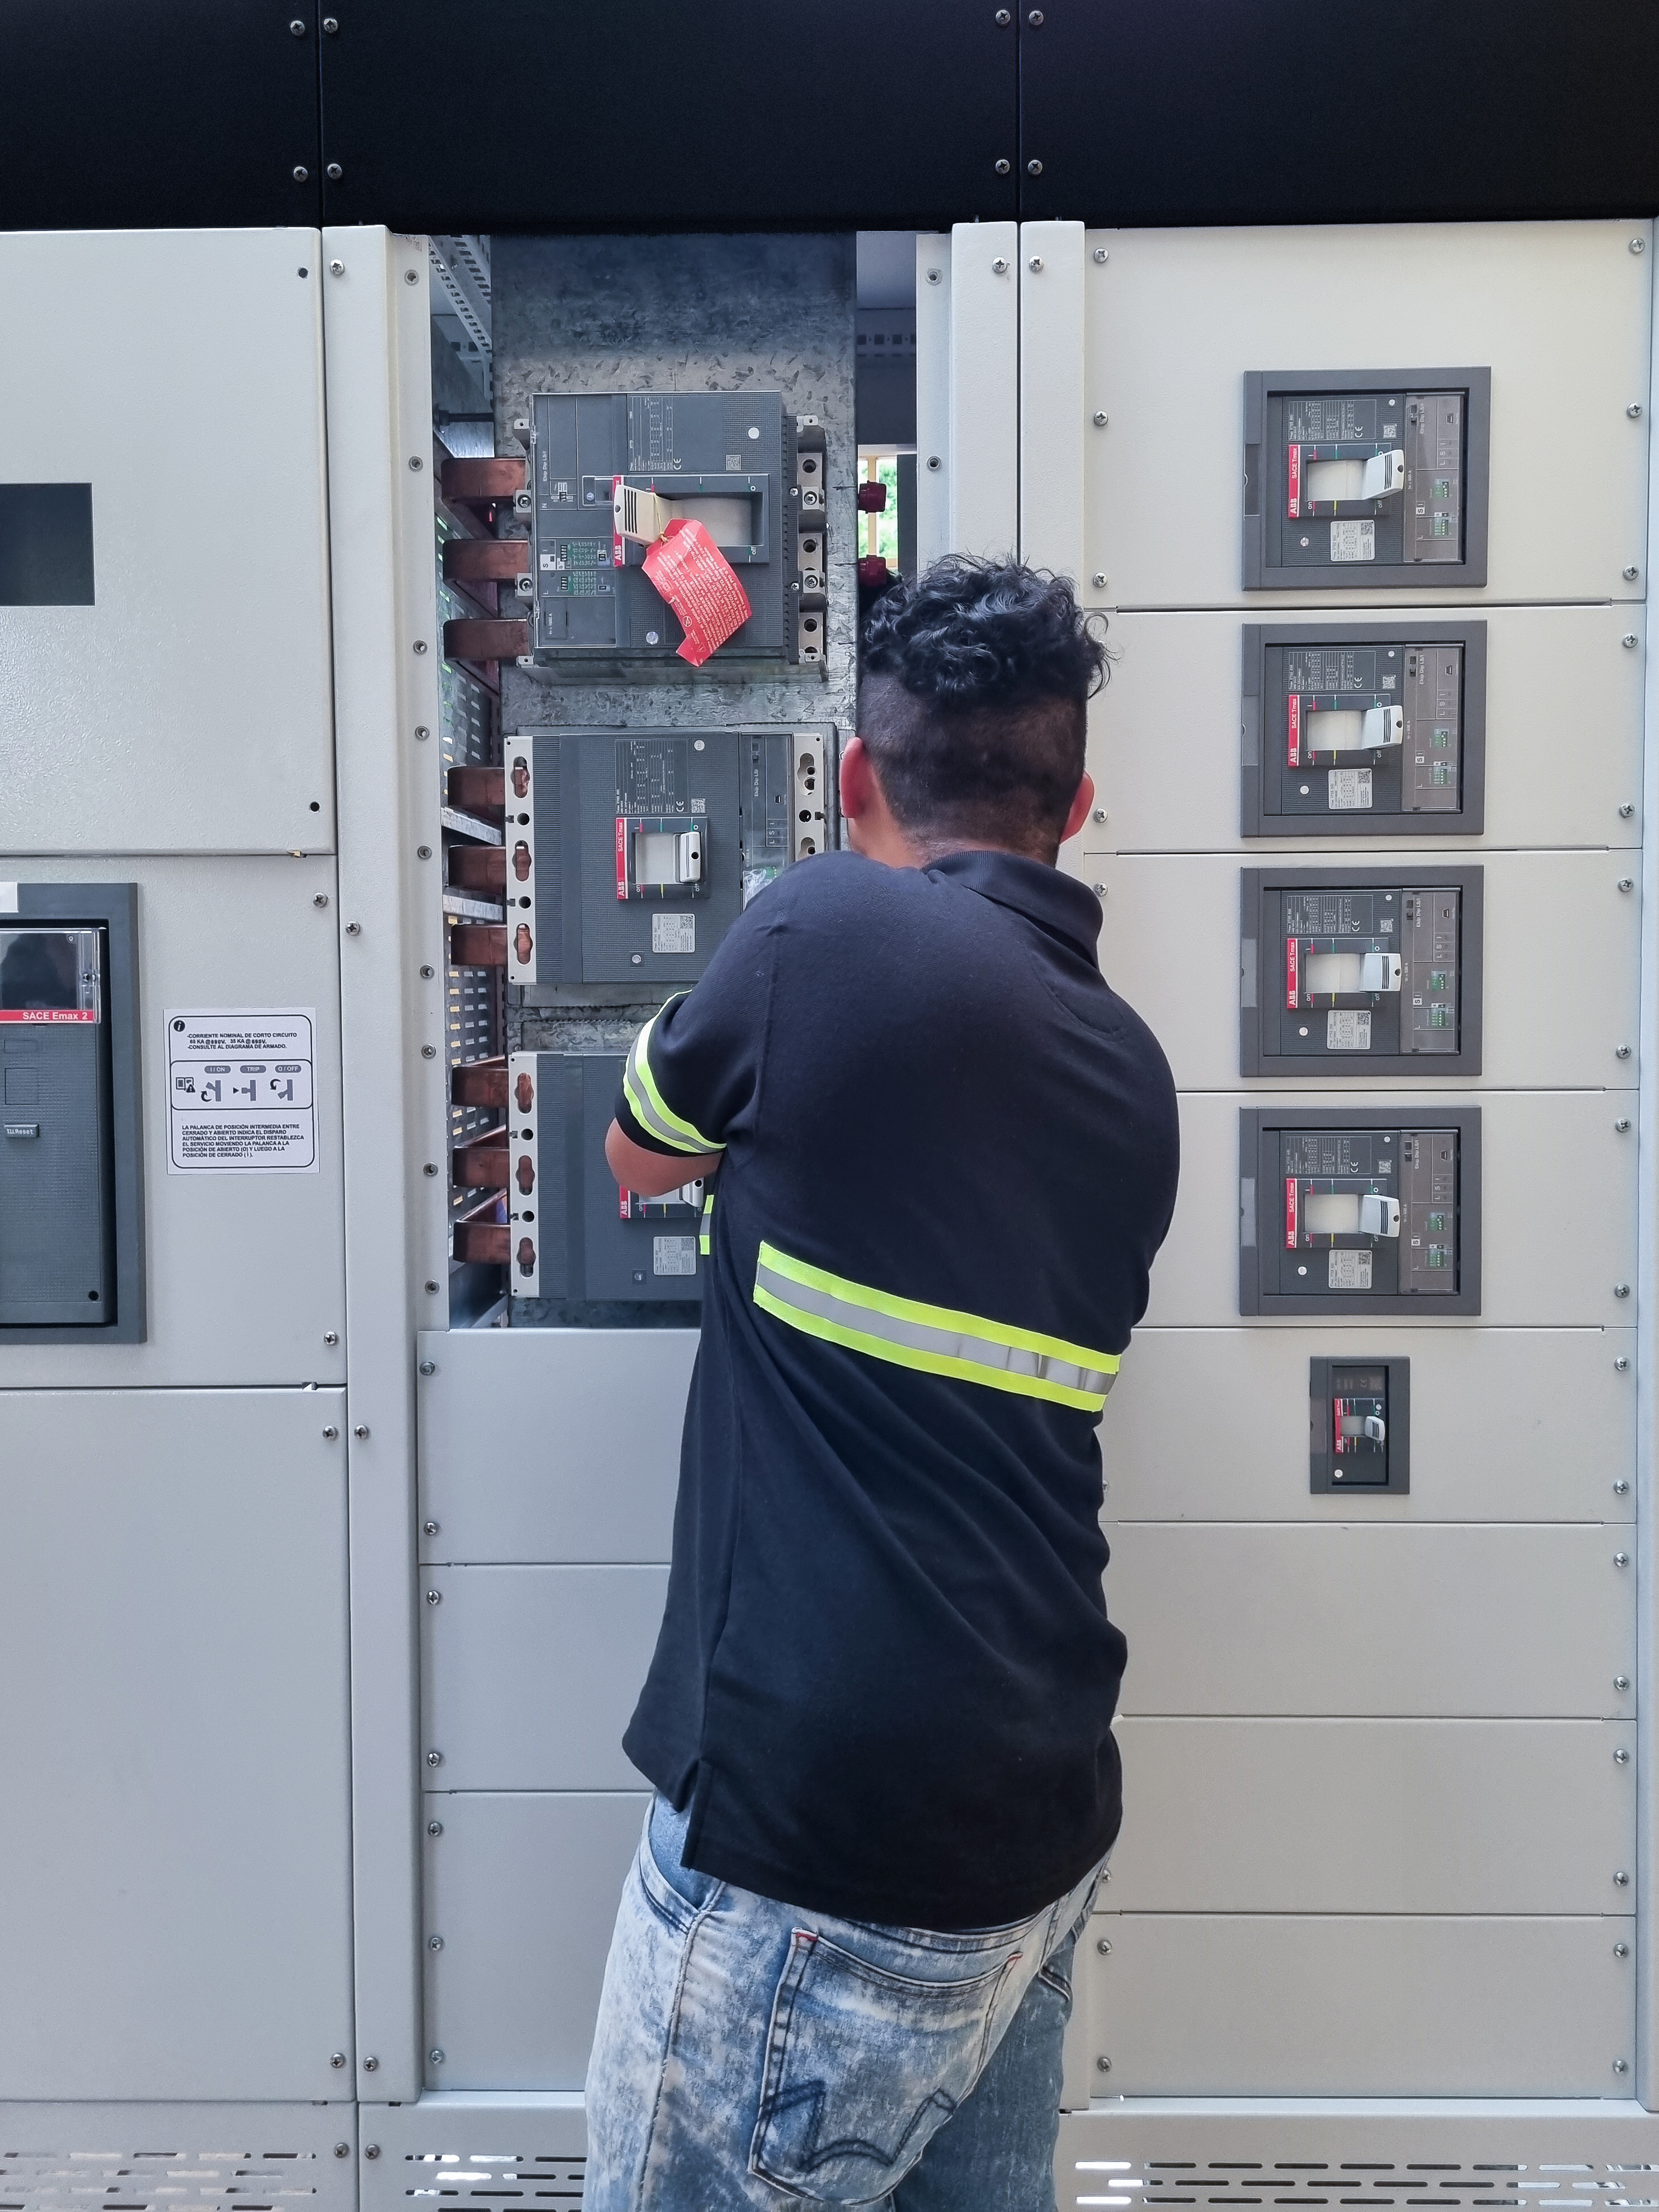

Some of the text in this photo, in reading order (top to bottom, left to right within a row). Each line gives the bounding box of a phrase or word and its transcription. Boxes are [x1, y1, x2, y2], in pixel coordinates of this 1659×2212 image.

[1355, 426, 1363, 438] CE
[1308, 501, 1313, 510] on
[1353, 677, 1363, 689] CE
[636, 884, 641, 893] on
[1351, 920, 1360, 932] CE
[23, 1012, 88, 1020] SACE Emax 2
[1350, 1161, 1358, 1172] CE
